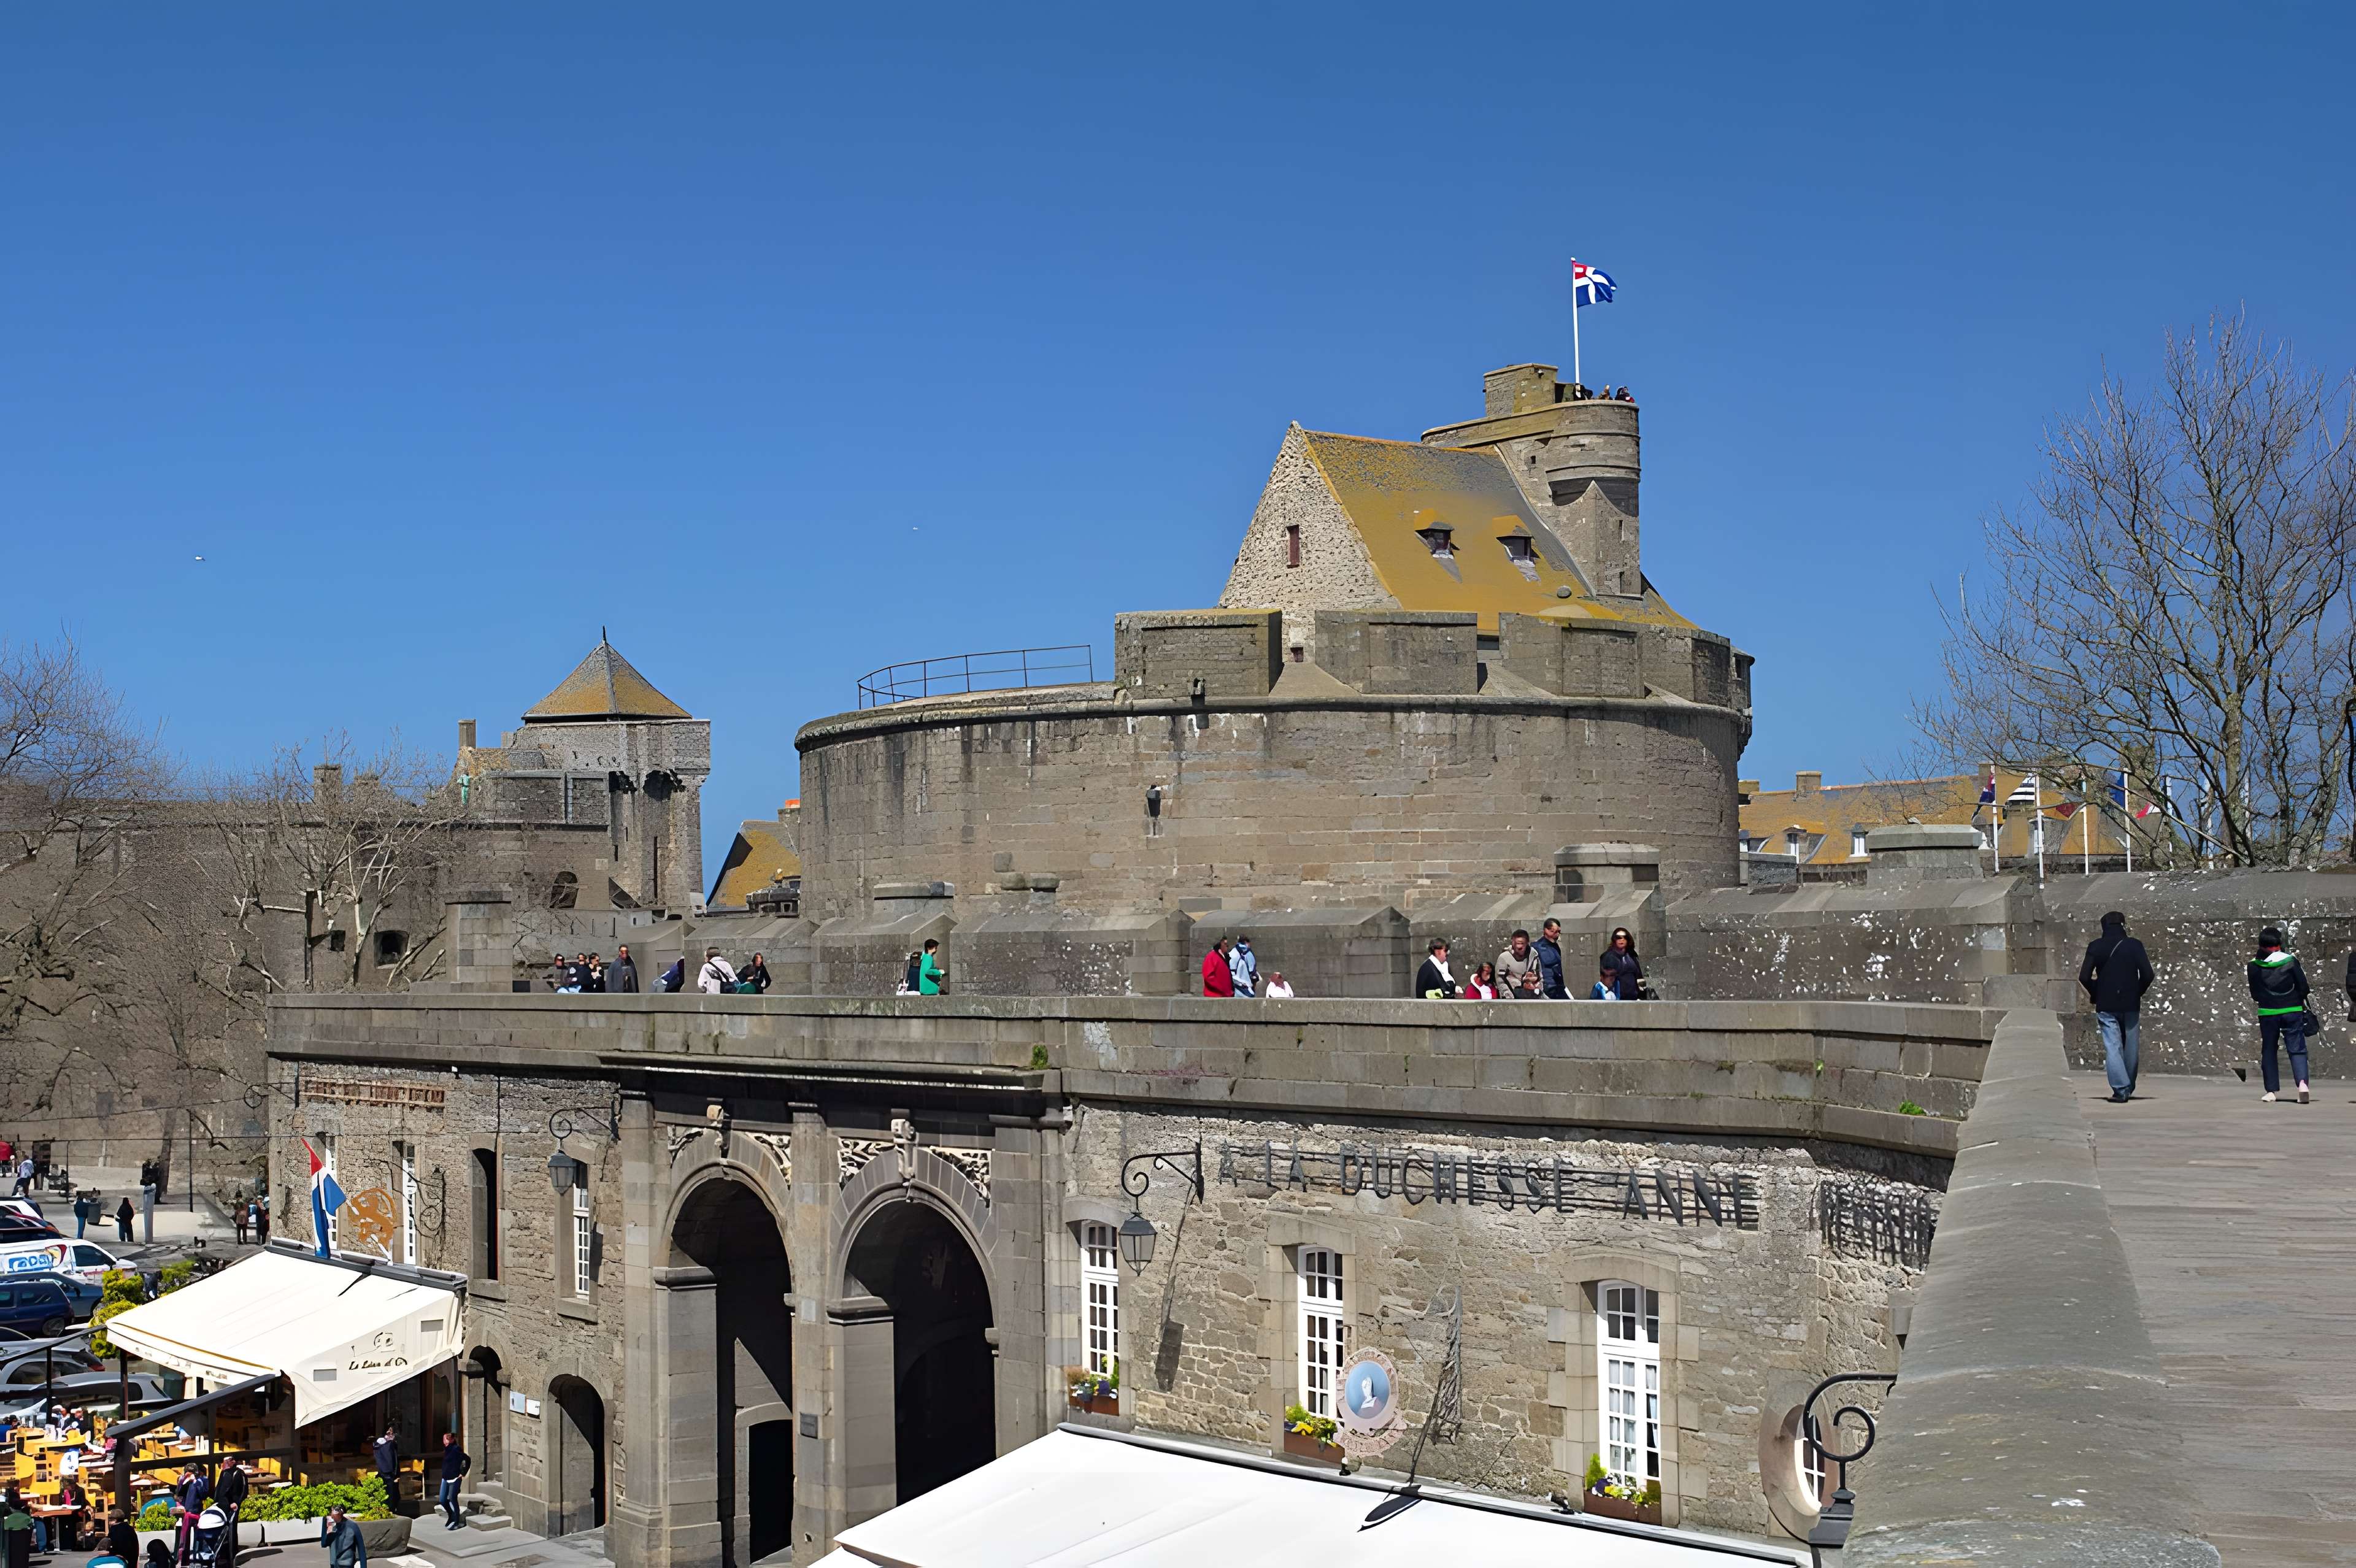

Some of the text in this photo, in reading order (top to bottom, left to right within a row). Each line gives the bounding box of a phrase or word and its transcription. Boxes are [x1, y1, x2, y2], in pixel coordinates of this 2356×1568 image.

[1266, 1134, 1307, 1193] LA
[1340, 1143, 1575, 1214] DUCHESSE
[1623, 1169, 1759, 1231] ANNE
